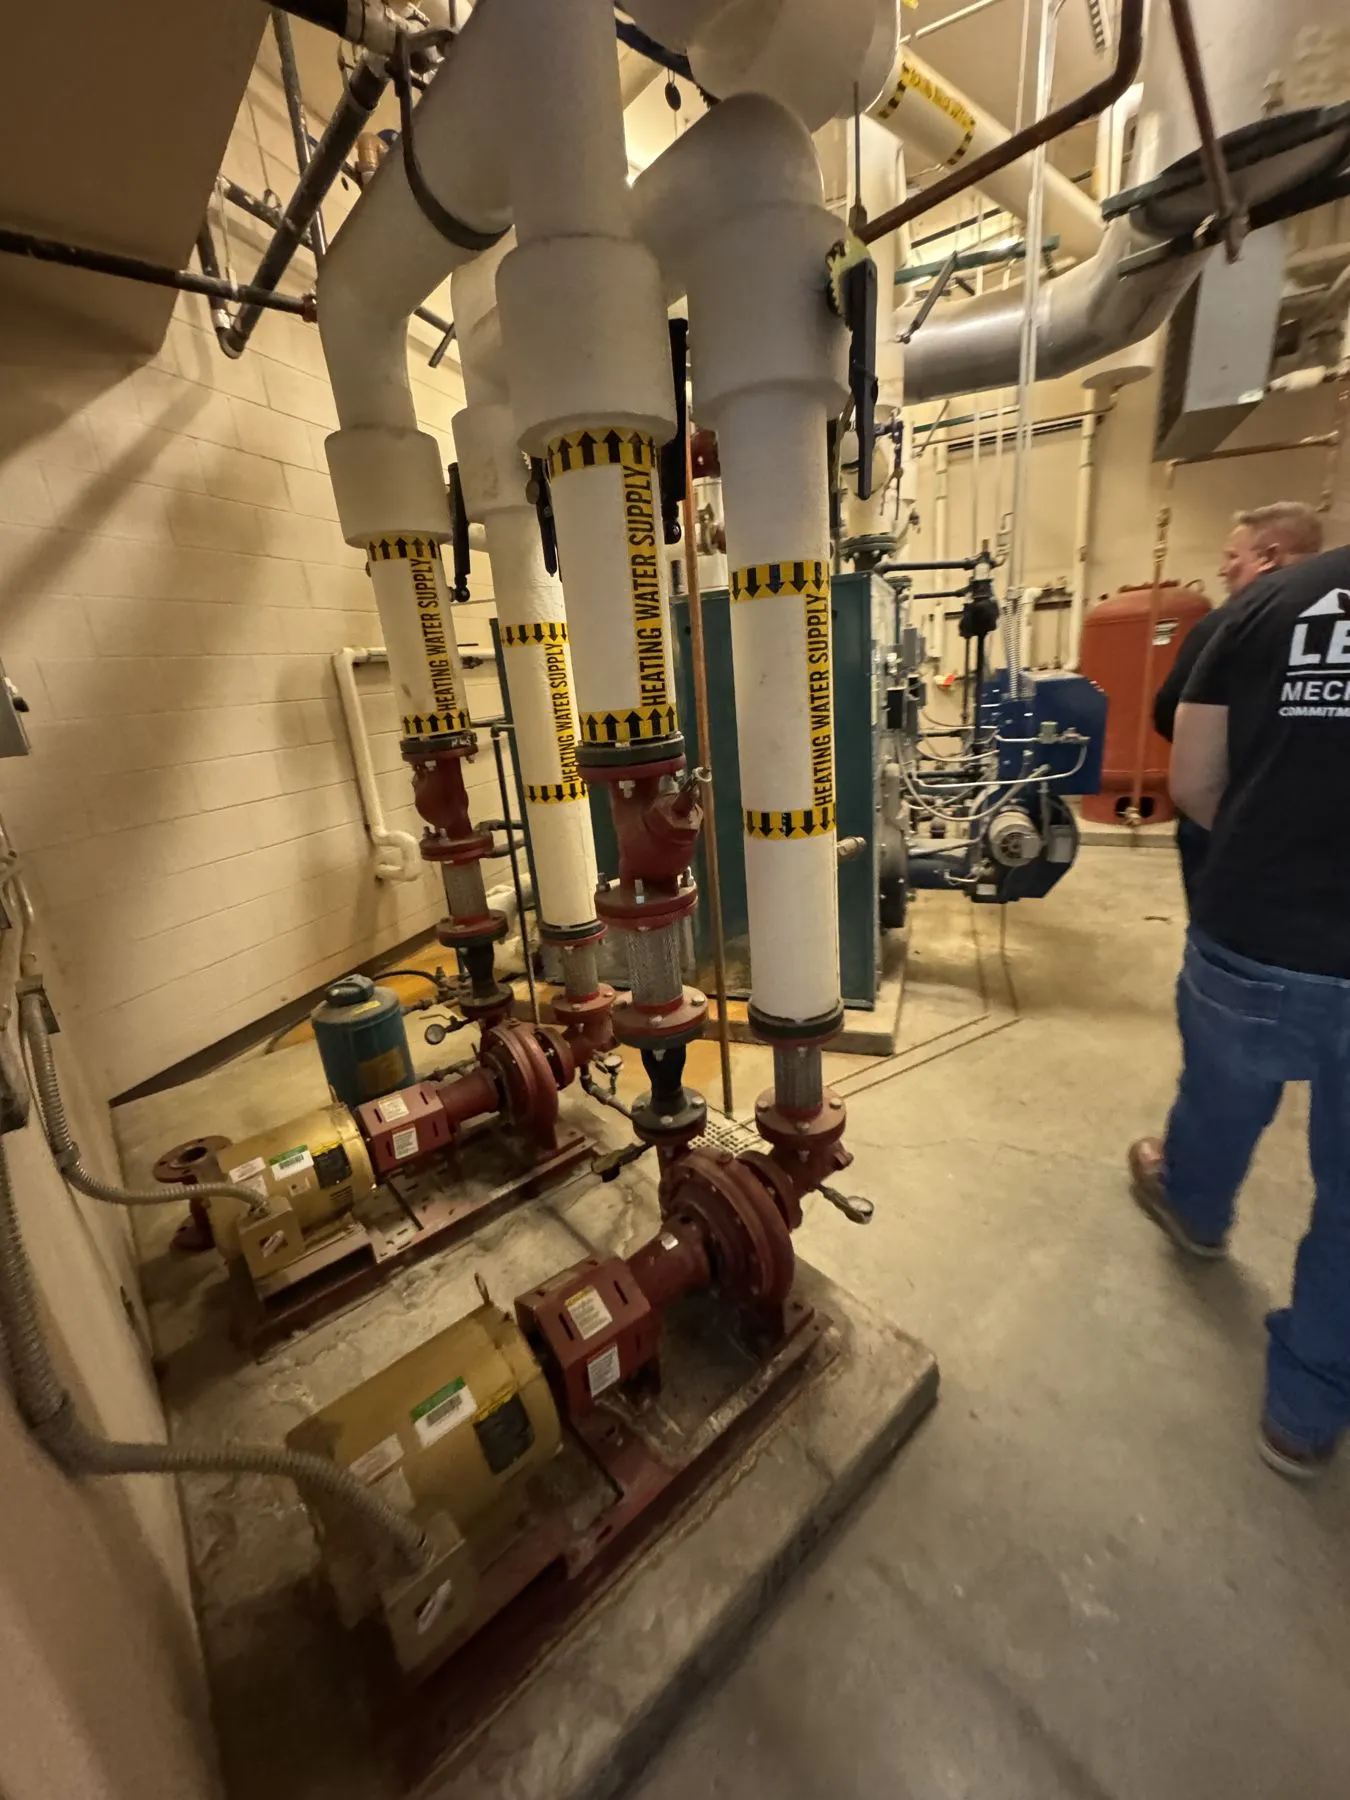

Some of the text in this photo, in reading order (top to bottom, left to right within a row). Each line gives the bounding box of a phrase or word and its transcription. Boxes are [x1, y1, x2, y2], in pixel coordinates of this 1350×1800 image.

[410, 558, 457, 712] HEATING WATER SUPPLY
[623, 464, 667, 708] HEATING WATER SUPPLY
[545, 643, 580, 783] HEATING WATER SUPPLY
[806, 593, 833, 807] HEATING WATER SUPPLY
